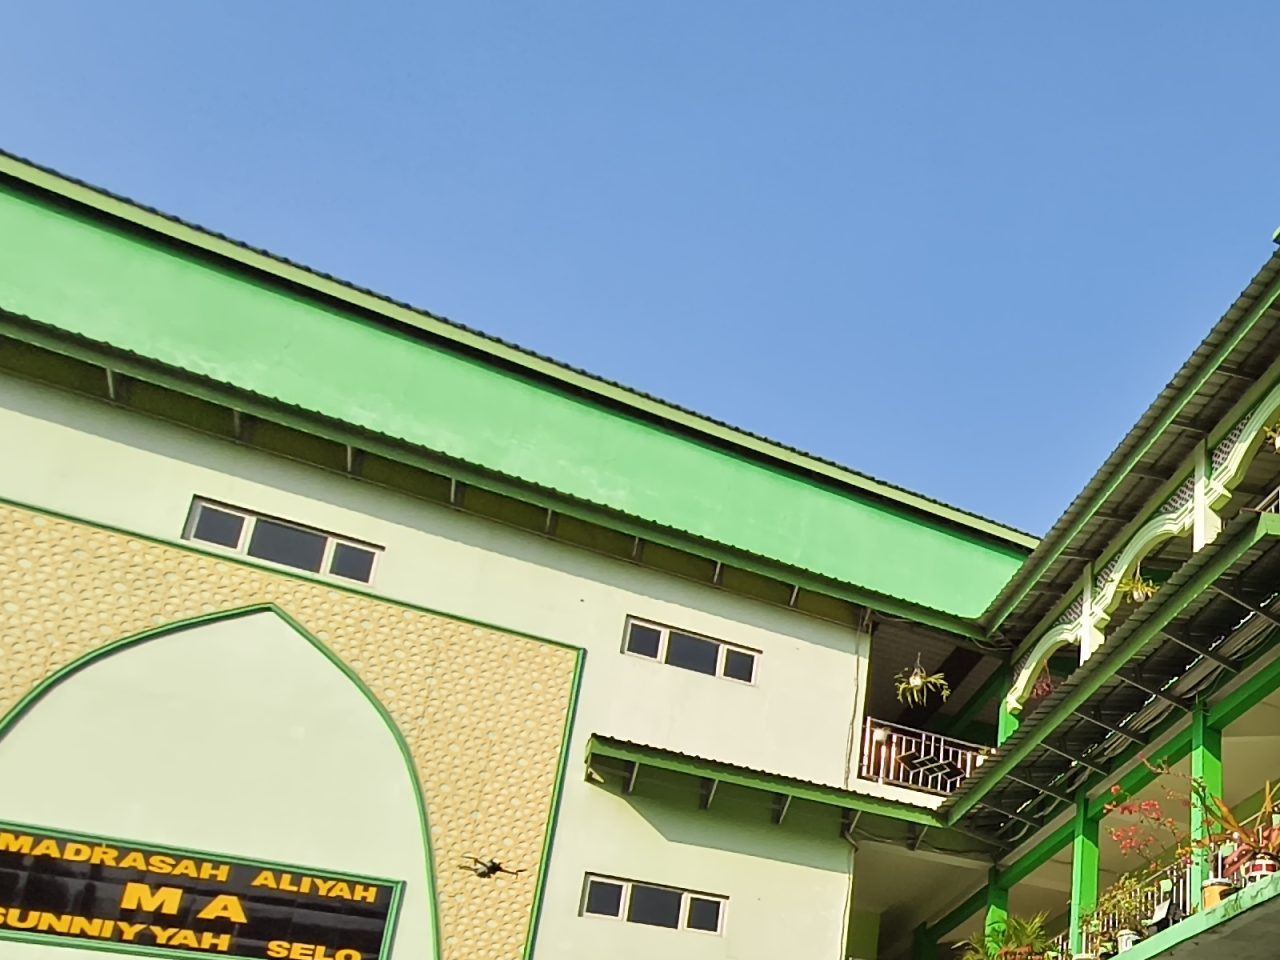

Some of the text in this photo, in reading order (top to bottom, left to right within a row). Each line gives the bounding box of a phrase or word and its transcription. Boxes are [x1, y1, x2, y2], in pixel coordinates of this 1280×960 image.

[0, 832, 378, 903] MADRASAH ALIYAH
[0, 906, 231, 952] UNNIYYAH
